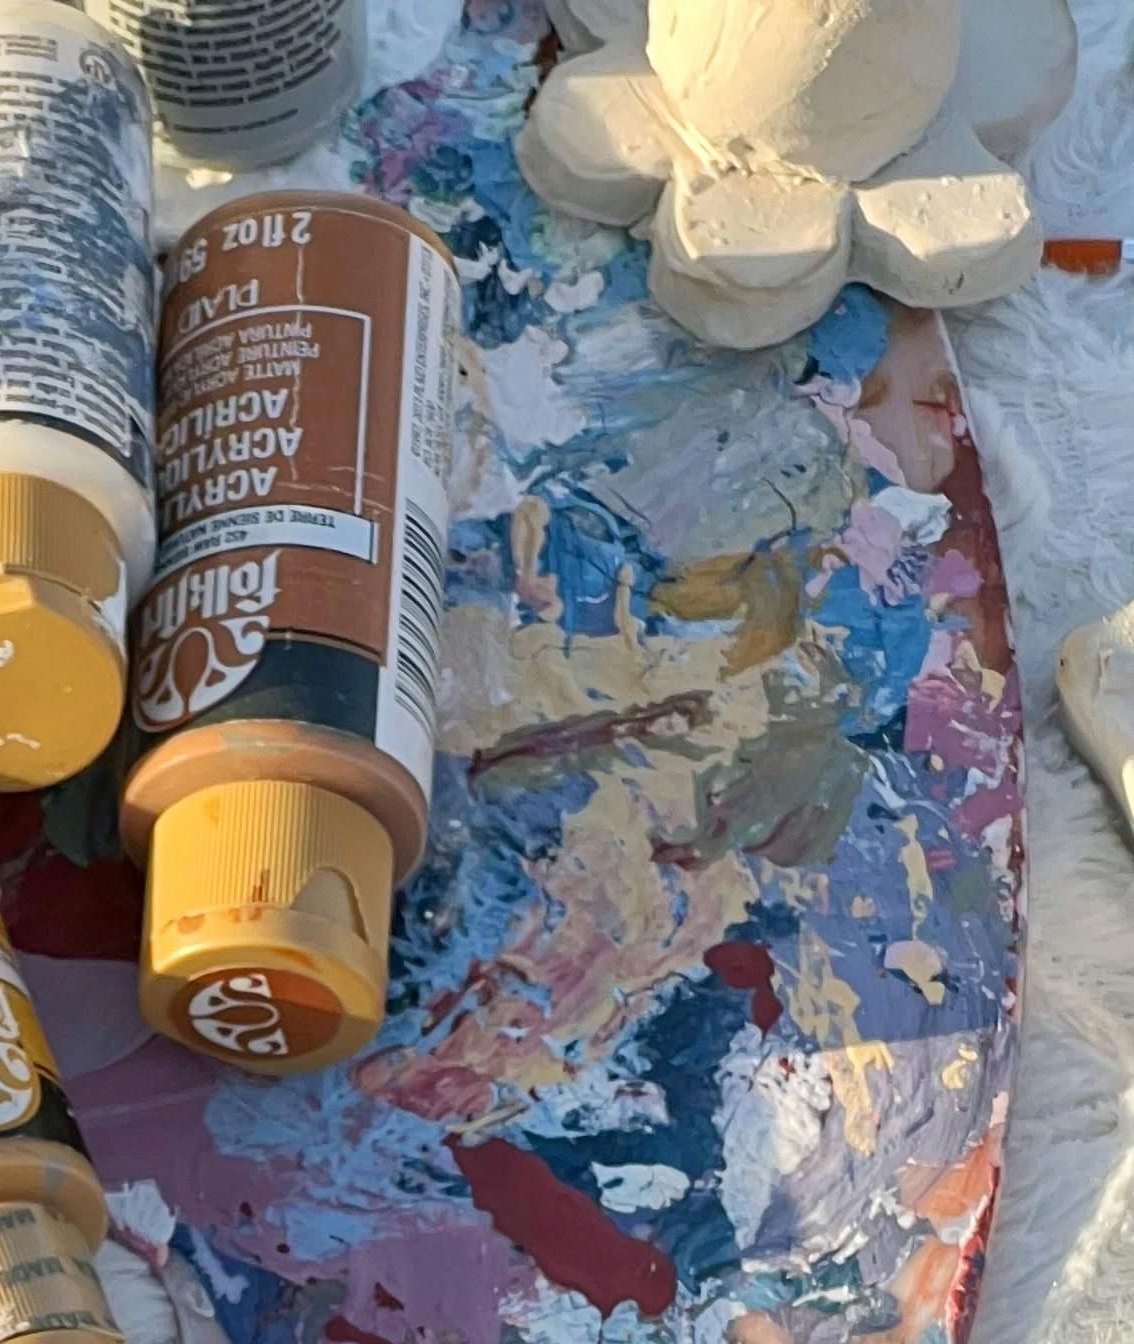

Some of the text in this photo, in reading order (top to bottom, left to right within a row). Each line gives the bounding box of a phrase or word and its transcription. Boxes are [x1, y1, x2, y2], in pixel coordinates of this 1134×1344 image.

[221, 217, 259, 252] oz
[262, 213, 287, 248] fl
[291, 211, 314, 246] 2
[177, 277, 260, 335] PLAID
[158, 386, 290, 457] ACRÍLIC
[264, 509, 285, 524] DE
